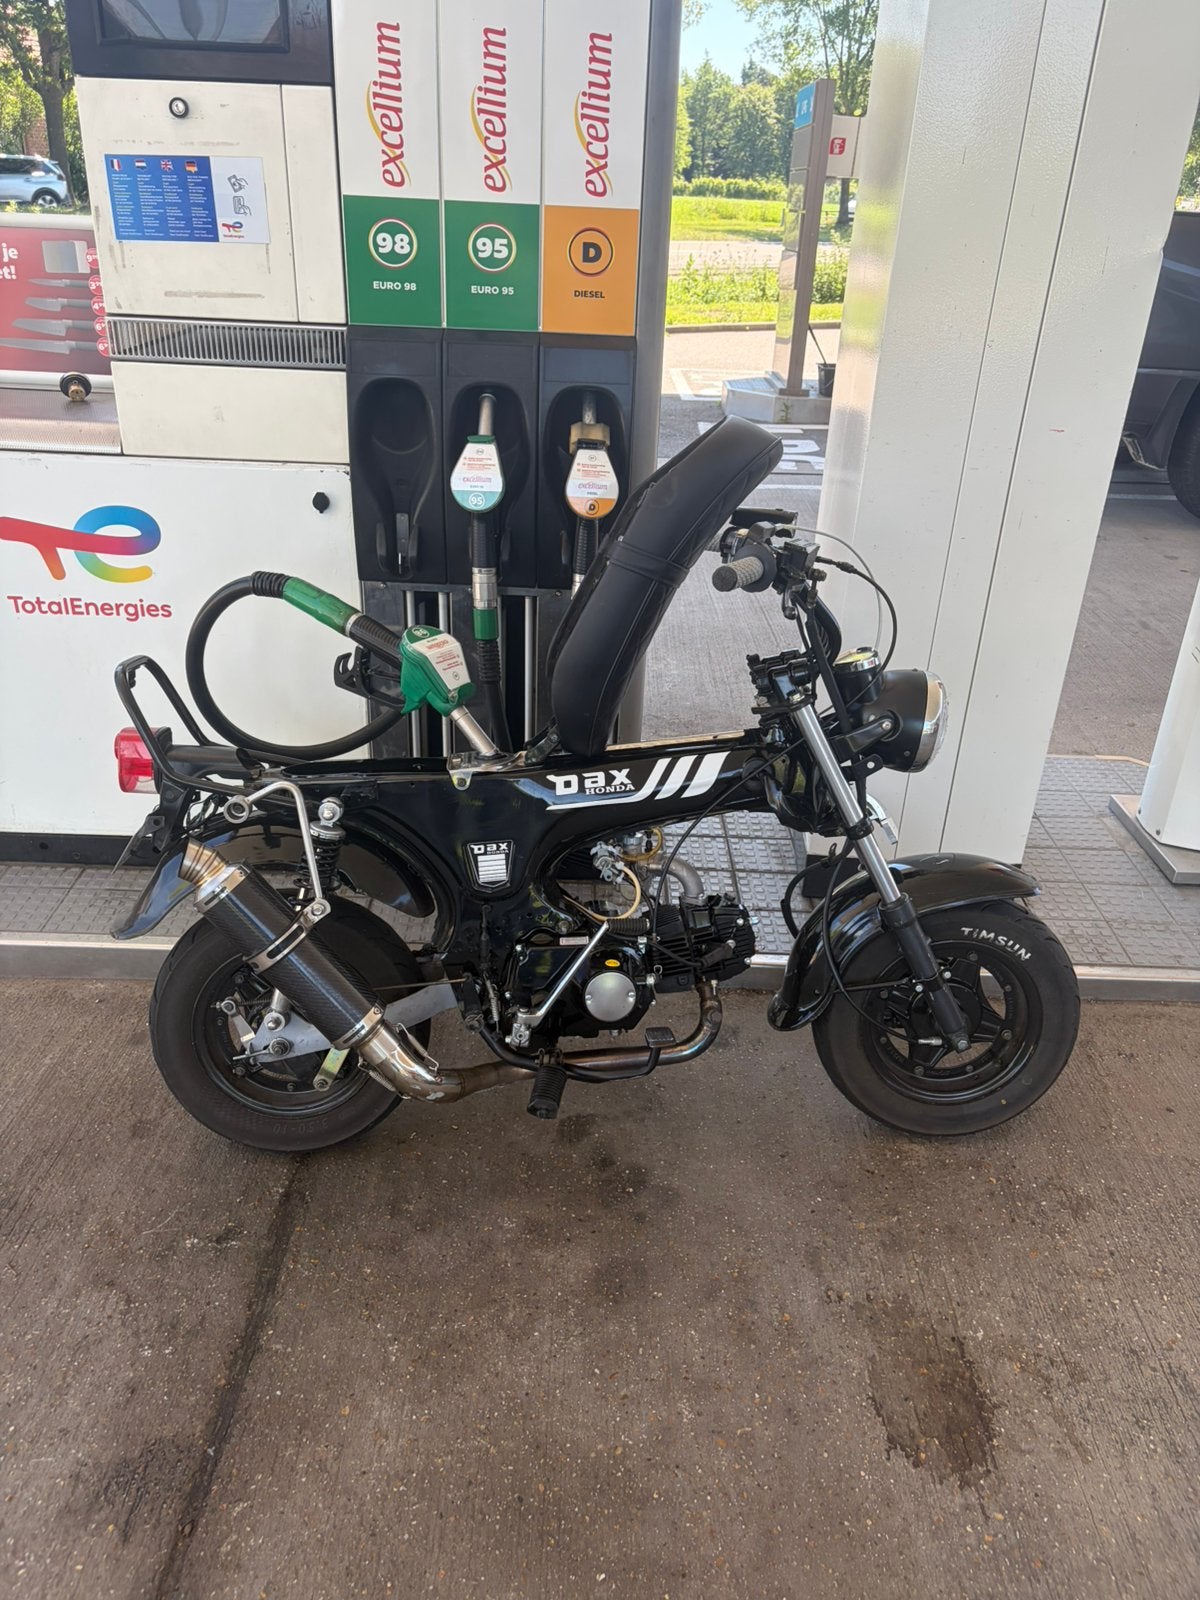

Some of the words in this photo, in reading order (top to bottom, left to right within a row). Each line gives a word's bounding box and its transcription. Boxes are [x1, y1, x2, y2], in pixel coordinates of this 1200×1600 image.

[371, 22, 406, 188] excellium
[475, 28, 507, 193] excellium
[579, 33, 612, 198] excellium
[1, 242, 19, 263] je
[375, 232, 411, 255] 98
[475, 237, 510, 259] 95
[581, 241, 603, 264] D
[373, 281, 401, 290] EURO
[404, 282, 417, 291] 98
[471, 285, 499, 294] EURO
[501, 286, 514, 295] 95
[573, 289, 605, 299] DIESEL
[471, 496, 483, 505] 95
[7, 596, 172, 622] TotalEnergies
[585, 783, 635, 795] HONDA
[960, 927, 1032, 960] TIMSUN
